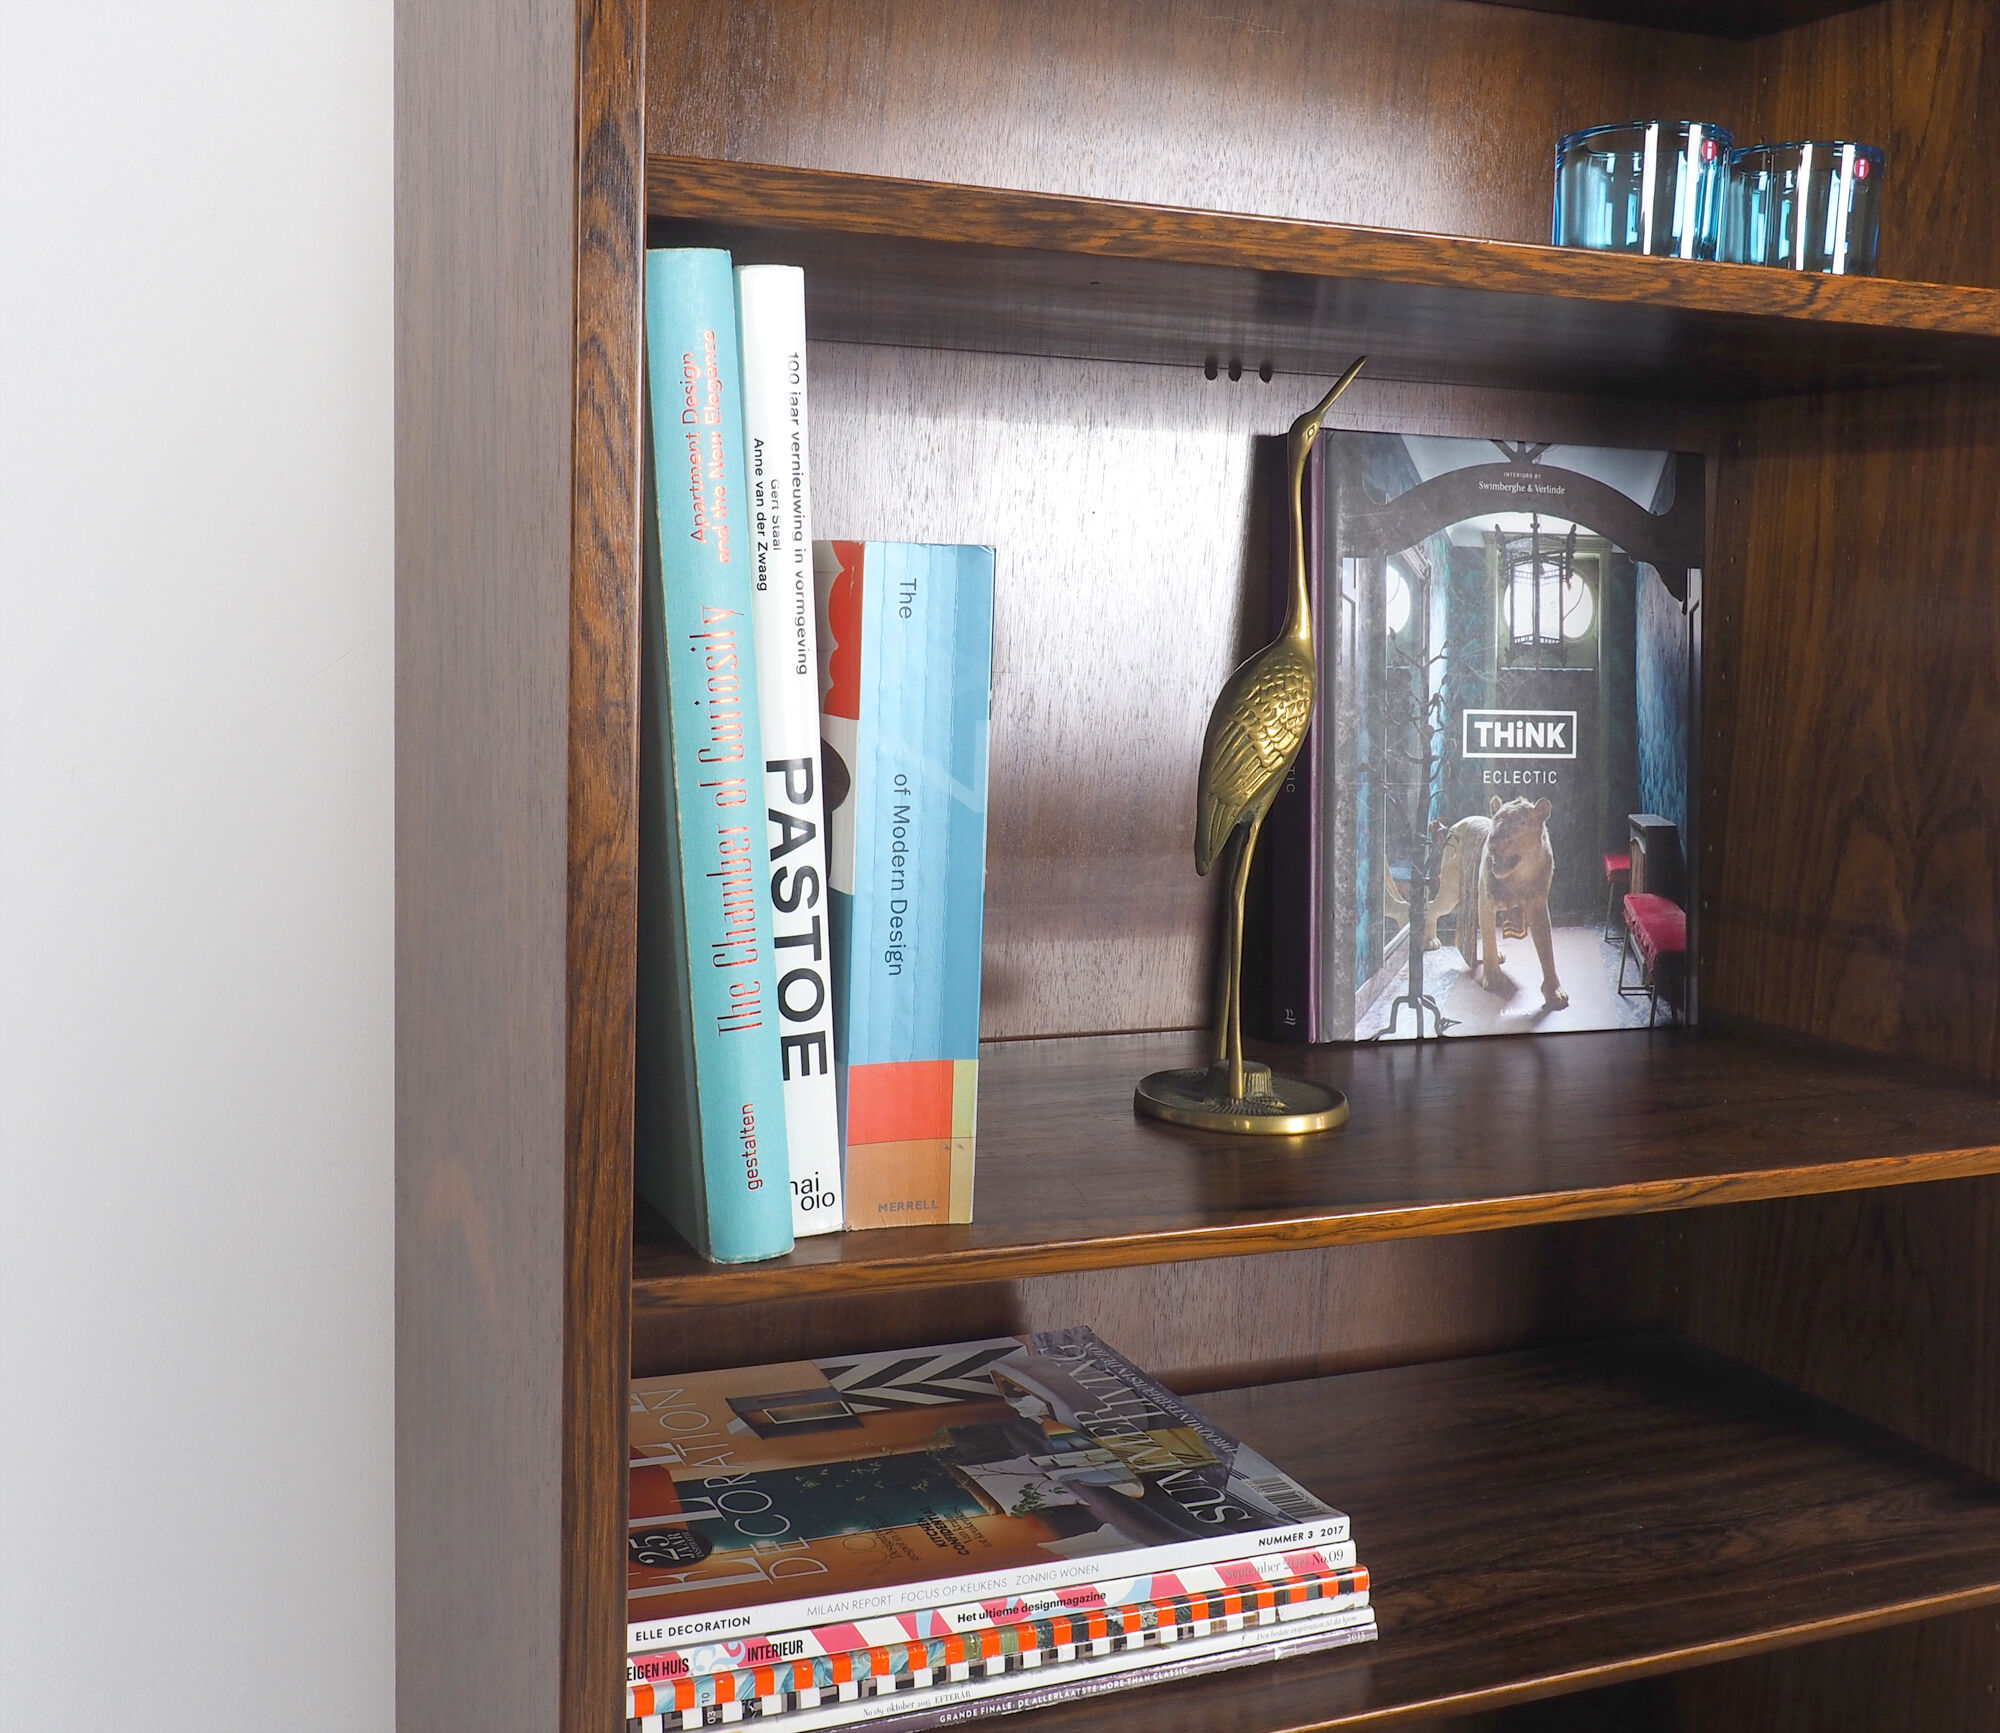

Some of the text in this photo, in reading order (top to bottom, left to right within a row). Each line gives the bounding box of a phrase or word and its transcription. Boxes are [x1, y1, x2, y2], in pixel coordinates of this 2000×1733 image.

[787, 352, 800, 385] 100
[679, 352, 711, 544] Apartment Design
[704, 328, 731, 563] and the New Elegance
[791, 431, 805, 542] vernieuwing
[754, 438, 768, 591] Anne van der Zwaag
[770, 479, 782, 551] Gert Staal
[1478, 481, 1566, 494] Swimberghe & Verlinde
[794, 548, 806, 564] in
[795, 570, 809, 675] vormgeving
[884, 578, 917, 977] The of Modern Design
[1483, 770, 1557, 784] ECLECTIC
[688, 604, 763, 1038] The Chamber of Curiosity
[765, 756, 828, 1081] PASTOE
[739, 1103, 763, 1190] gestalten
[878, 1199, 939, 1213] MERRELL
[1038, 1344, 1170, 1422] LIVING
[650, 1387, 829, 1579] DECORATION
[1073, 1411, 1255, 1524] SUMMER
[629, 1535, 680, 1565] 25
[668, 1532, 695, 1559] JAAR
[915, 1516, 948, 1548] KITCHEN
[920, 1506, 969, 1556] CONFIDENTIAL
[627, 1662, 660, 1681] EIGEN
[662, 1658, 690, 1676] HUIS
[747, 1640, 804, 1662] INTERIEUR
[957, 1611, 976, 1624] Het
[978, 1606, 1019, 1620] ultieme
[1021, 1591, 1107, 1616] designmagazine
[1225, 1560, 1282, 1580] September
[636, 1525, 1345, 1642] ELLE DECORATION MILAAN REPORT FOCUS OP KEUKENS ZONNIG WONEN NUMMER 3 2017
[886, 1700, 915, 1713] oktober
[939, 1708, 978, 1723] GRANDE
[1017, 1698, 1030, 1709] DE
[1032, 1685, 1097, 1705] ALLERLAATSTE
[1100, 1679, 1125, 1692] MORE
[1126, 1674, 1151, 1686] THAN
[1152, 1667, 1188, 1680] CLASSIC
